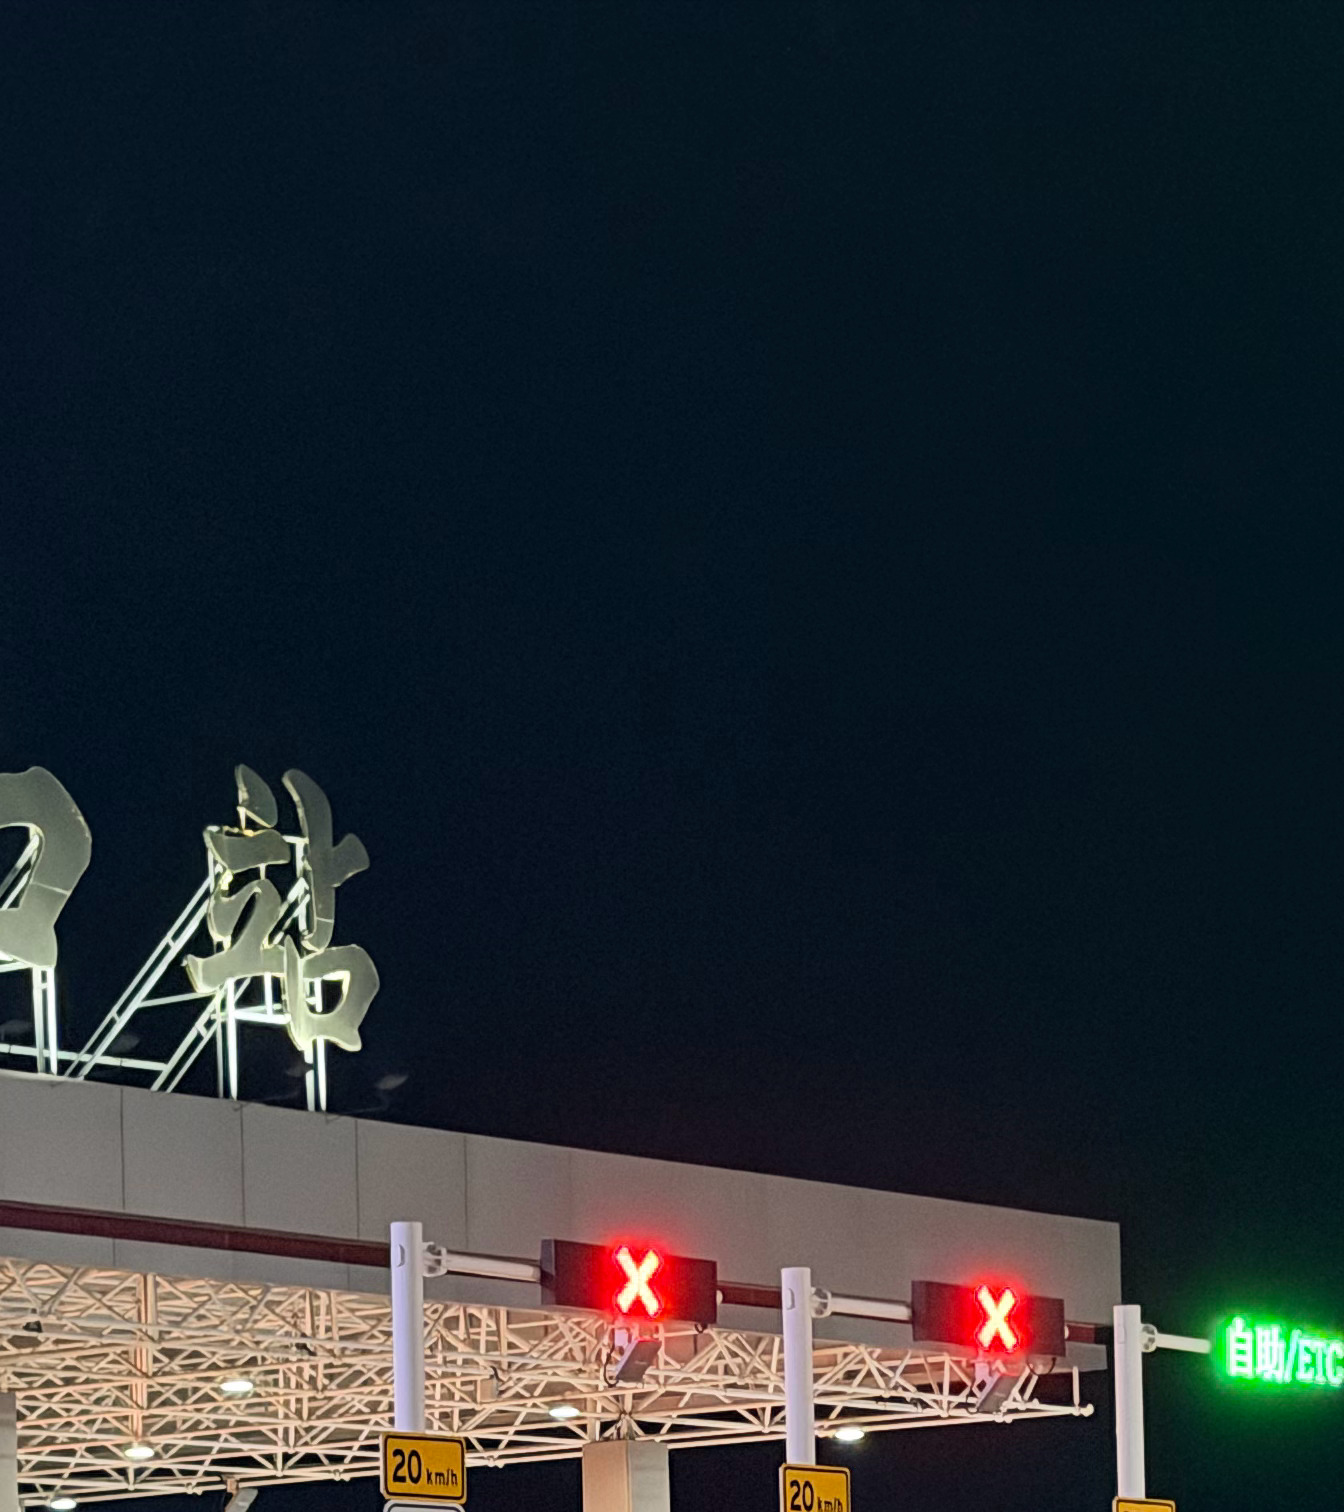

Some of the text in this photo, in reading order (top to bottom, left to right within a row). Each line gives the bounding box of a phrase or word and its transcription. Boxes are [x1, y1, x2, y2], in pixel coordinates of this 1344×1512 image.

[392, 1449, 458, 1487] 20 km/h
[789, 1479, 813, 1512] 20
